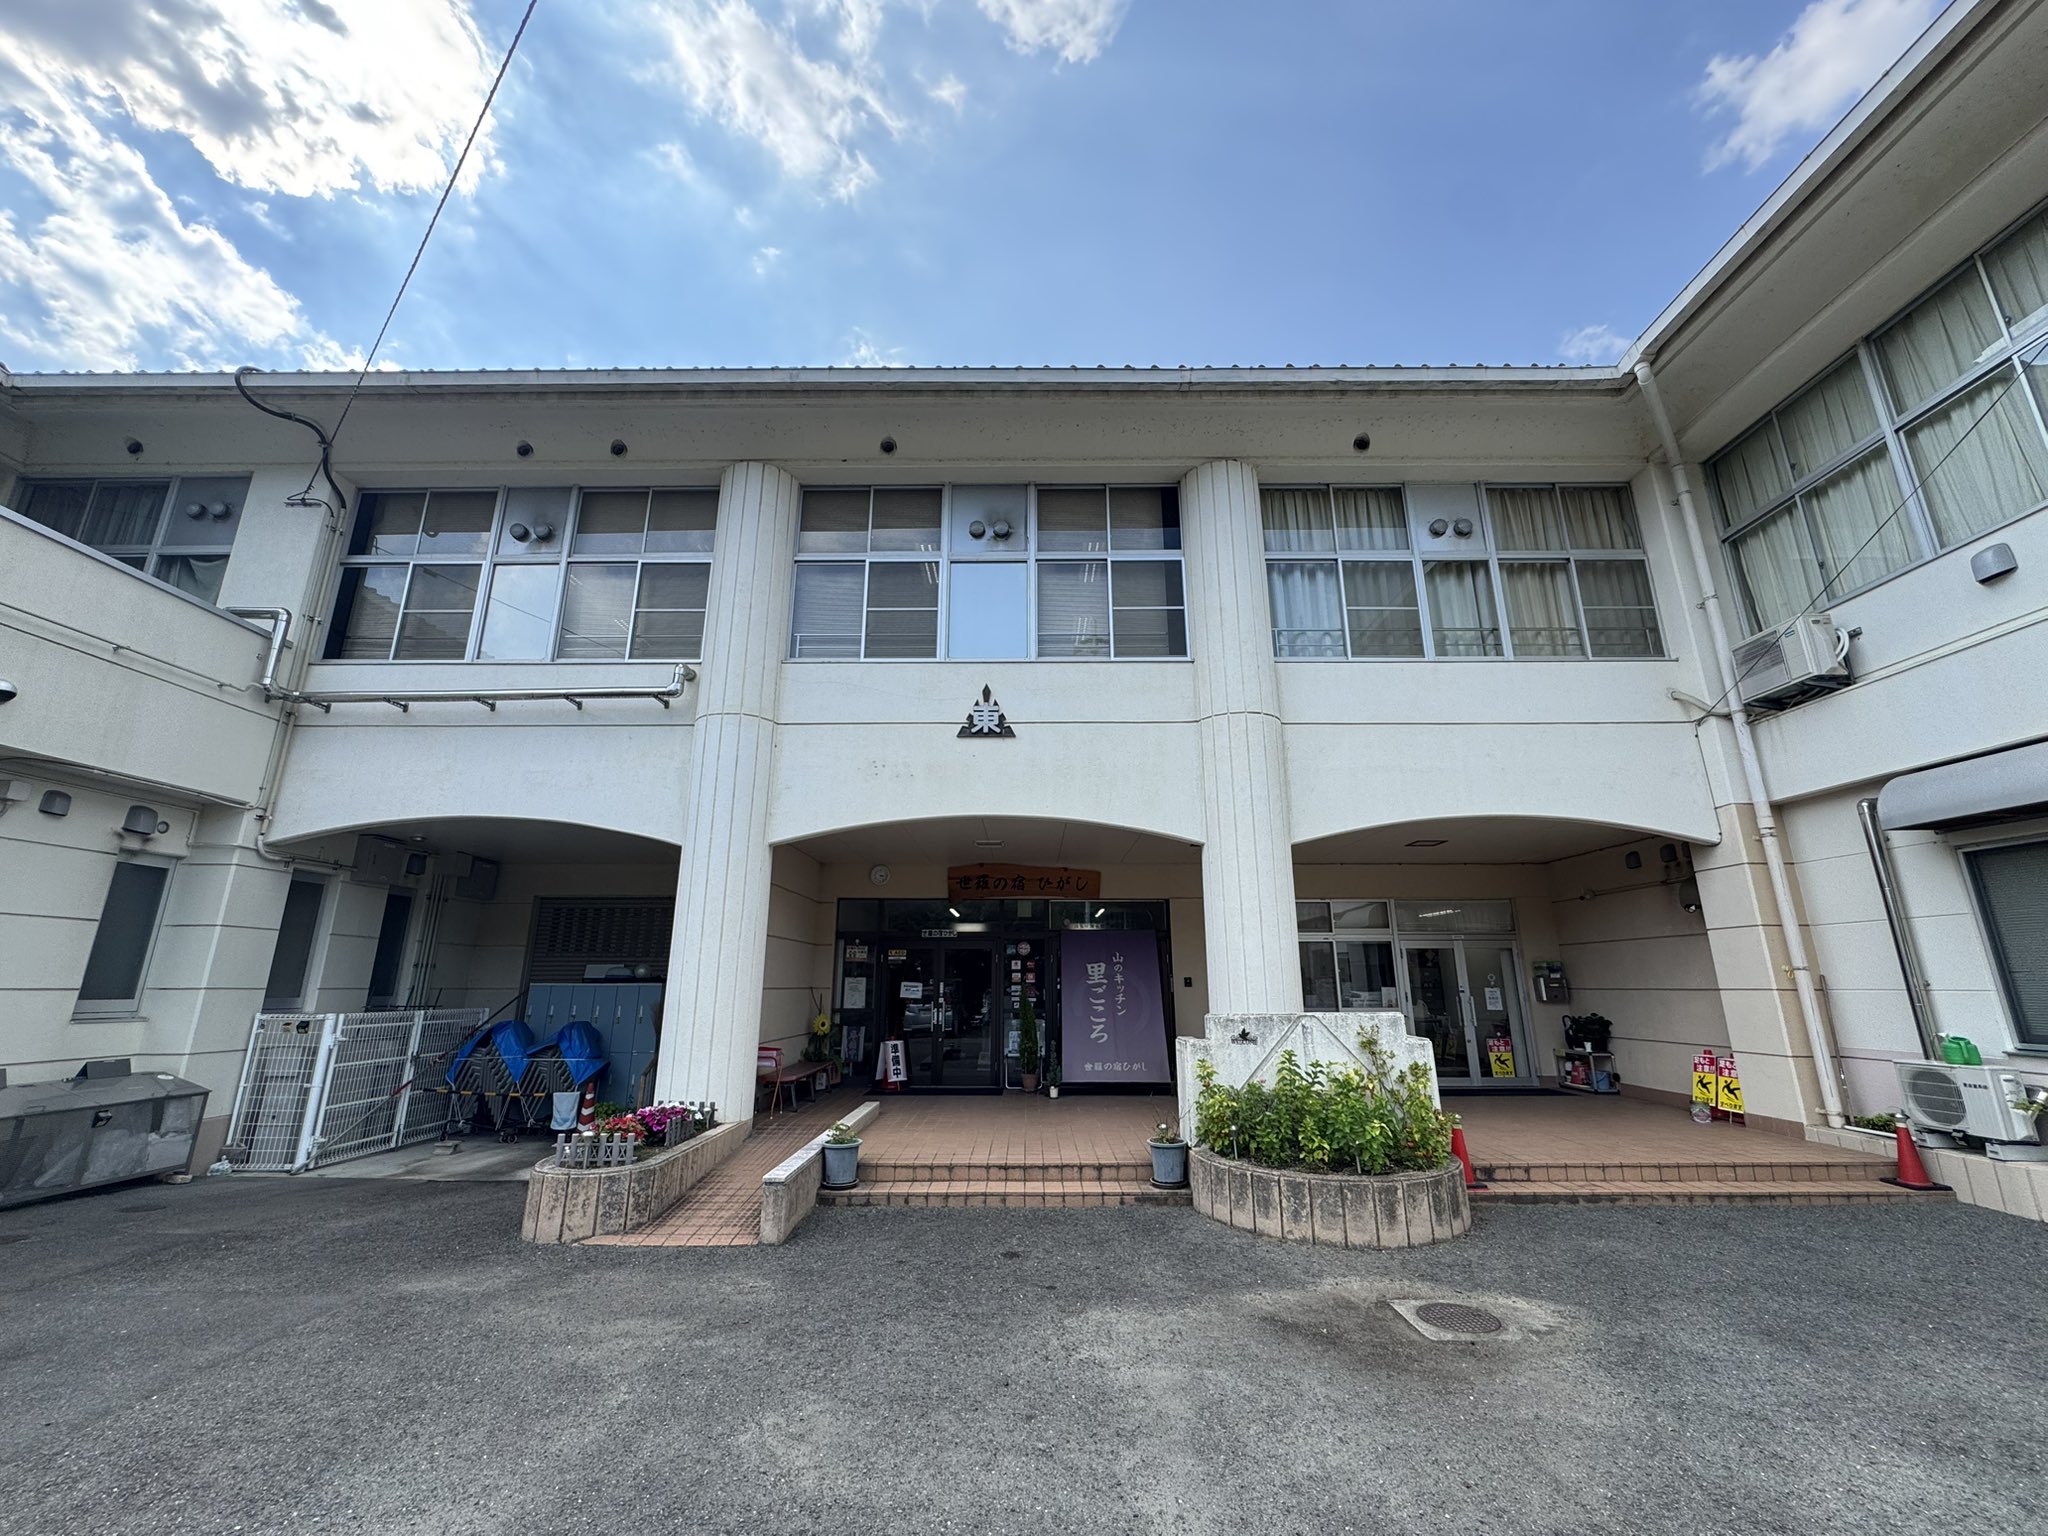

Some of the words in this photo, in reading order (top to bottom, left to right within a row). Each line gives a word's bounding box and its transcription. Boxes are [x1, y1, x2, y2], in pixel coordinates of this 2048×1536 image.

[971, 702, 1001, 733] 東
[957, 874, 1026, 891] 世羅の宿
[1038, 876, 1089, 891] ひがし
[1112, 952, 1127, 1016] 山のキッチン
[1086, 962, 1108, 1043] 里ごころ
[890, 1043, 902, 1078] 準備中
